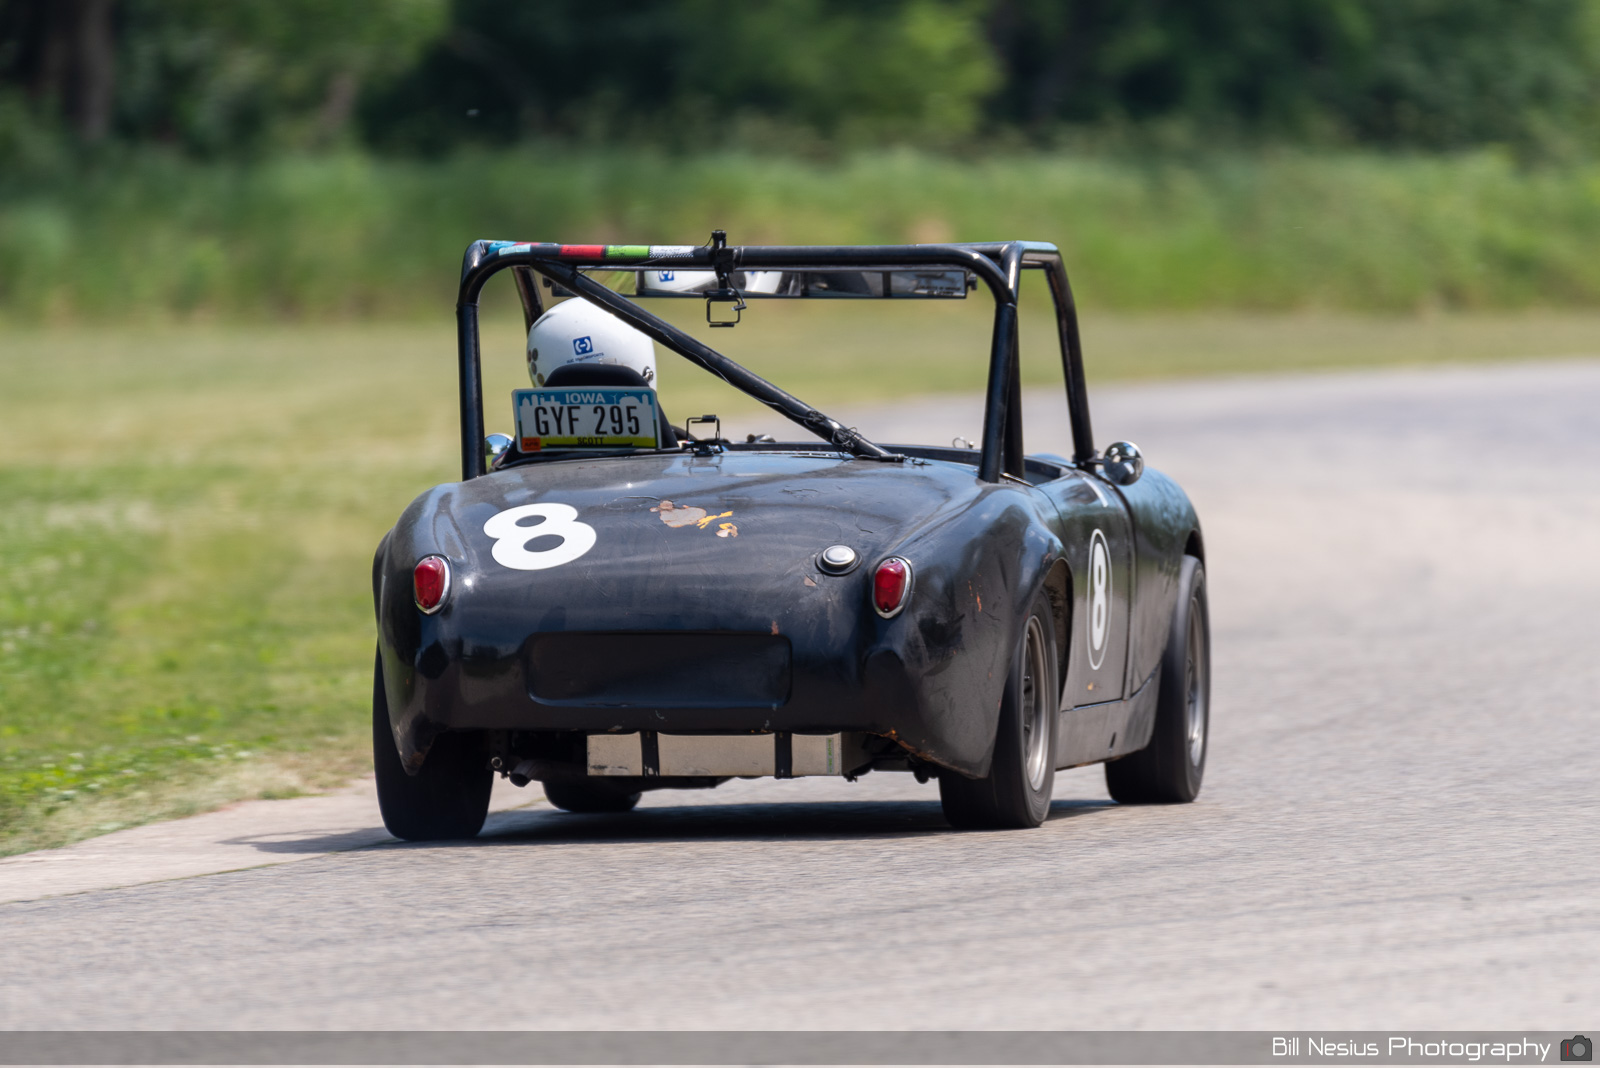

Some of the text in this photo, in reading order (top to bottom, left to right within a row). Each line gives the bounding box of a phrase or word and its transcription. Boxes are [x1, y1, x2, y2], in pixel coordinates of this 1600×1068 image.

[565, 392, 606, 404] IOWA
[534, 405, 640, 436] GYF 295
[577, 436, 604, 446] SCOTT
[483, 502, 597, 571] 8
[1092, 542, 1107, 651] 8
